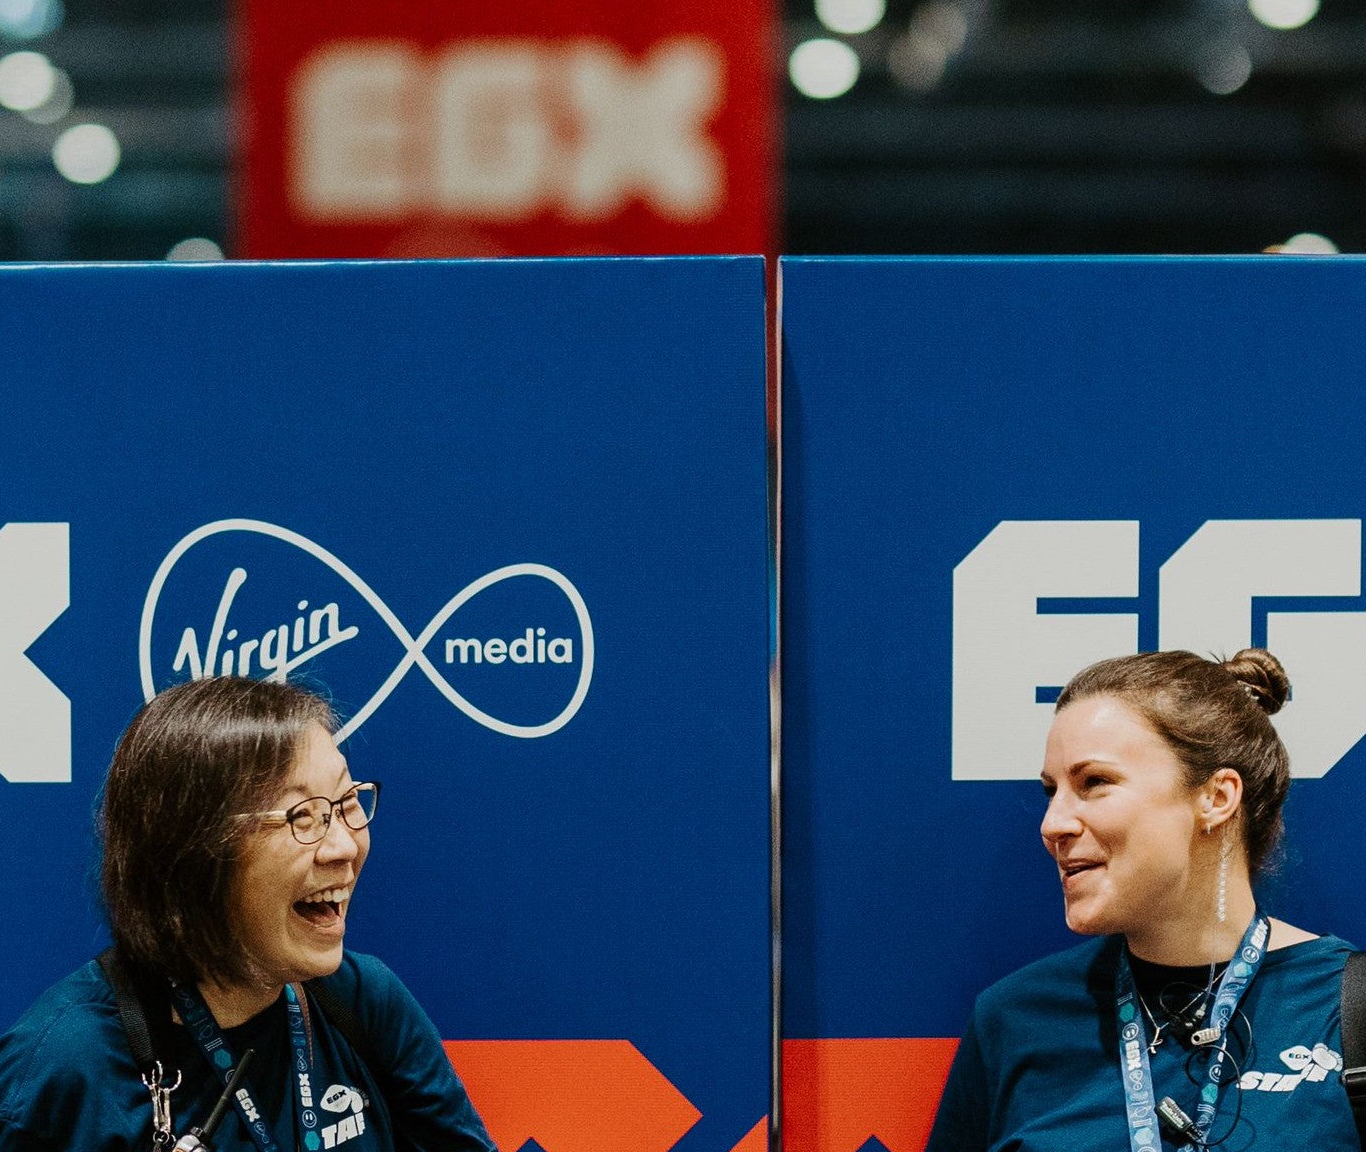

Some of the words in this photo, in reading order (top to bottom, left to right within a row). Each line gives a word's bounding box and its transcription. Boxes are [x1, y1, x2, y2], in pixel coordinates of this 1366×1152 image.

[290, 40, 725, 218] EGX
[172, 567, 359, 685] Virgin
[445, 627, 573, 664] media
[235, 1088, 260, 1123] EGX
[298, 1073, 313, 1107] EGX
[326, 1089, 347, 1105] EGX
